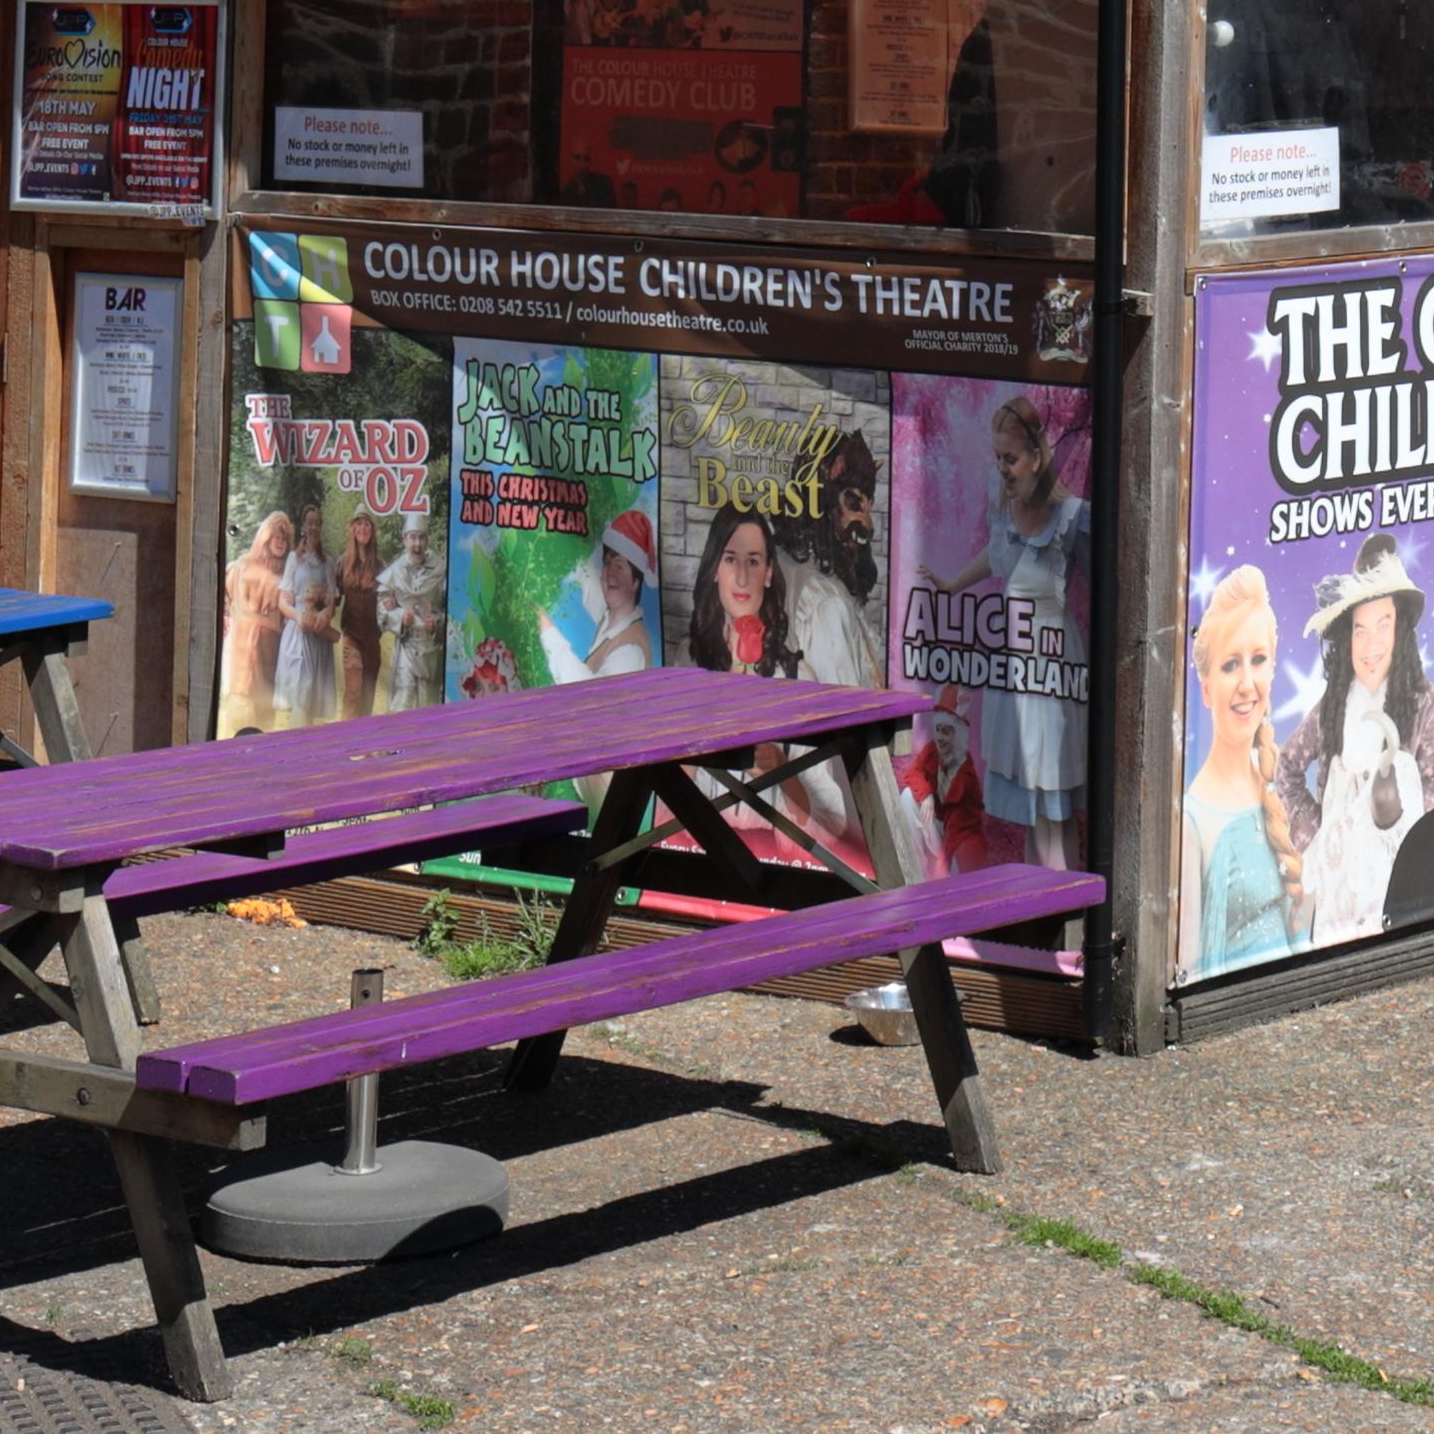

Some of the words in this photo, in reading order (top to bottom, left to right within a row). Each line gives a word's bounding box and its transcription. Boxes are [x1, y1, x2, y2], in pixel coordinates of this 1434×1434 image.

[66, 74, 103, 83] CONTEST
[598, 60, 650, 77] COLOUR
[653, 62, 698, 79] HOUSE
[701, 64, 757, 80] THEATRE
[127, 66, 205, 110] NIGHT
[572, 77, 684, 108] COMEDY
[689, 81, 756, 112] CLUB
[68, 102, 96, 115] MAY
[28, 121, 45, 131] BAR
[46, 122, 68, 132] OPEN
[69, 123, 92, 133] FROM
[129, 126, 145, 135] BAR
[146, 127, 165, 136] OPEN
[166, 128, 187, 137] FROM
[305, 117, 347, 134] Please
[42, 138, 61, 149] FREE
[62, 138, 89, 149] EVENT
[144, 140, 164, 149] FREE
[165, 140, 187, 150] EVENT
[288, 139, 302, 150] No
[304, 140, 329, 151] stock
[332, 142, 342, 151] or
[345, 143, 377, 155] money
[380, 142, 396, 154] left
[399, 144, 409, 154] in
[1230, 146, 1273, 163] Please
[286, 154, 312, 166] these
[314, 157, 358, 169] premises
[360, 160, 411, 174] overnight!
[1212, 173, 1227, 185] No
[1230, 170, 1255, 184] stock
[1258, 172, 1268, 181] or
[1271, 169, 1303, 181] money
[1306, 165, 1320, 178] left
[1209, 191, 1237, 204] these
[1240, 187, 1284, 204] premises
[1287, 181, 1331, 197] overnight!
[365, 240, 500, 289] COLOUR
[511, 249, 626, 295] HOUSE
[639, 258, 844, 312] CHILDREN'S
[851, 274, 1015, 324] THEATRE
[105, 287, 147, 312] BAR
[371, 289, 401, 308] BOX
[403, 292, 457, 312] OFFICE:
[460, 297, 494, 315] 0208
[498, 299, 524, 317] 542
[527, 301, 563, 320] 5511
[576, 303, 770, 335] colourhousetheatre.co.uk
[905, 339, 943, 351] OFFICIAL
[945, 341, 982, 353] CHARITY
[984, 343, 1019, 355] 2018/19
[913, 329, 946, 341] MAYOR
[948, 331, 960, 341] OF
[962, 332, 1009, 344] MERTON'S
[1274, 288, 1401, 386] THE
[459, 360, 540, 423] JACK
[543, 386, 581, 418] AND
[587, 389, 621, 420] THE
[248, 395, 291, 420] THE
[670, 373, 839, 484] Beauty
[249, 419, 429, 466] WIZARD
[463, 417, 657, 482] BEANSTALK
[734, 455, 763, 475] and
[339, 470, 364, 491] OF
[365, 467, 429, 515] OZ
[461, 471, 494, 496] THIS
[497, 474, 587, 505] CHRISTMAS
[697, 456, 824, 519] Beast
[461, 500, 494, 526] AND
[497, 504, 540, 529] NEW
[544, 507, 588, 535] YEAR
[1270, 489, 1373, 543] SHOWS
[904, 587, 1035, 654] ALICE
[1041, 627, 1063, 658] IN
[903, 643, 1089, 704] WONDERLAND
